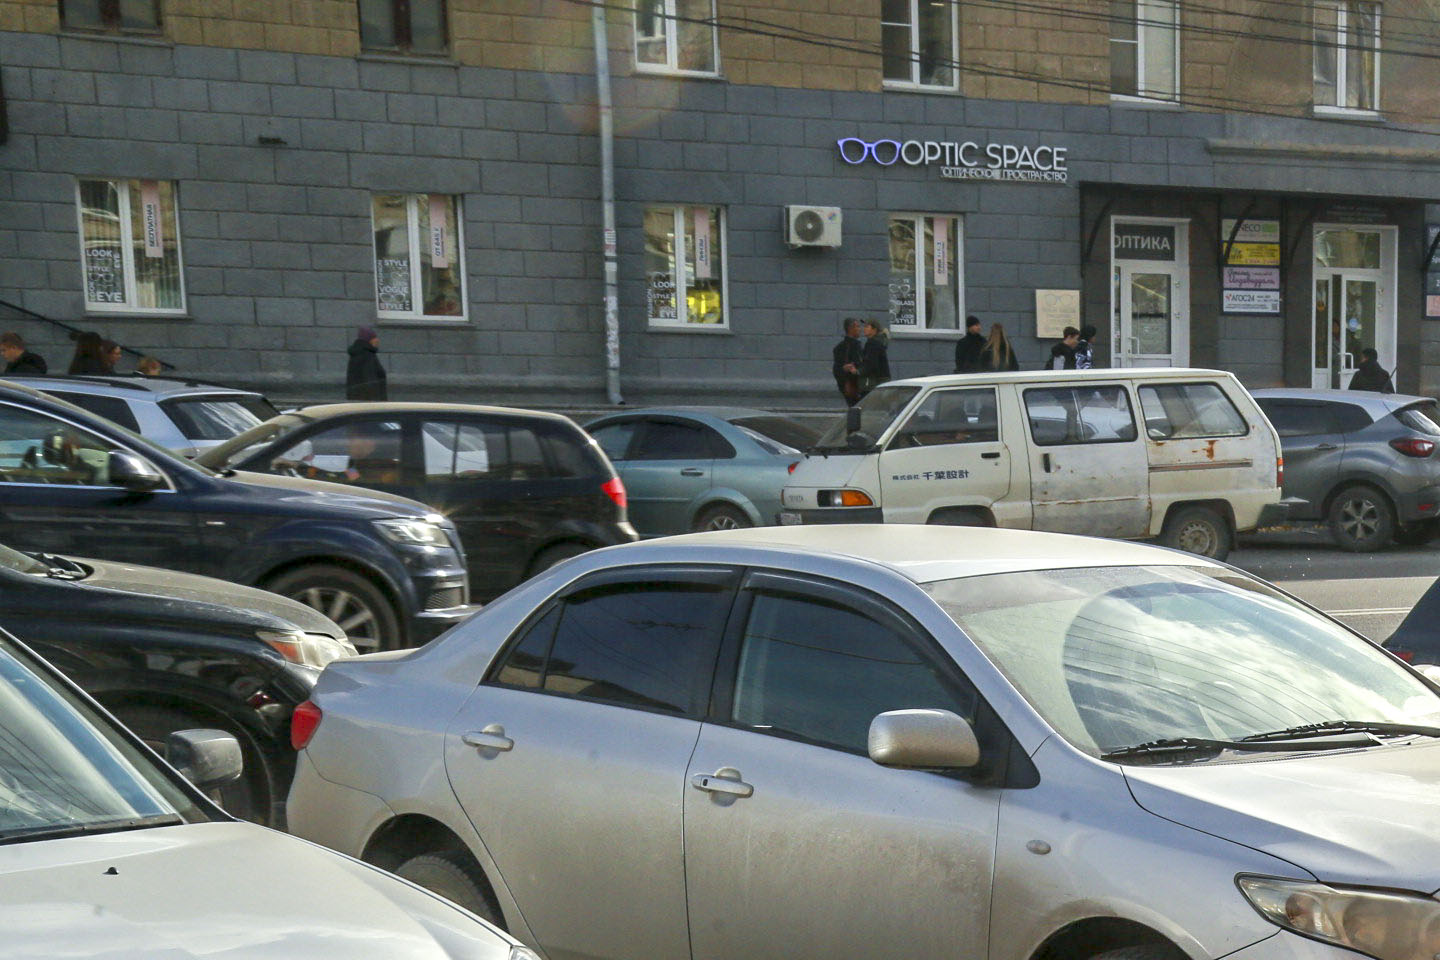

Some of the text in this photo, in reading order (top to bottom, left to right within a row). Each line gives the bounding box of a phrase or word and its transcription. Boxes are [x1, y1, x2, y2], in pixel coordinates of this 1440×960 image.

[901, 140, 1067, 171] OPTIC SPACE
[1002, 169, 1068, 182] ПРОСТРАНСТВО
[1114, 235, 1170, 250] ОПТИКА
[87, 249, 113, 257] LOOK
[379, 286, 409, 294] VOGUE
[97, 292, 122, 302] EYE
